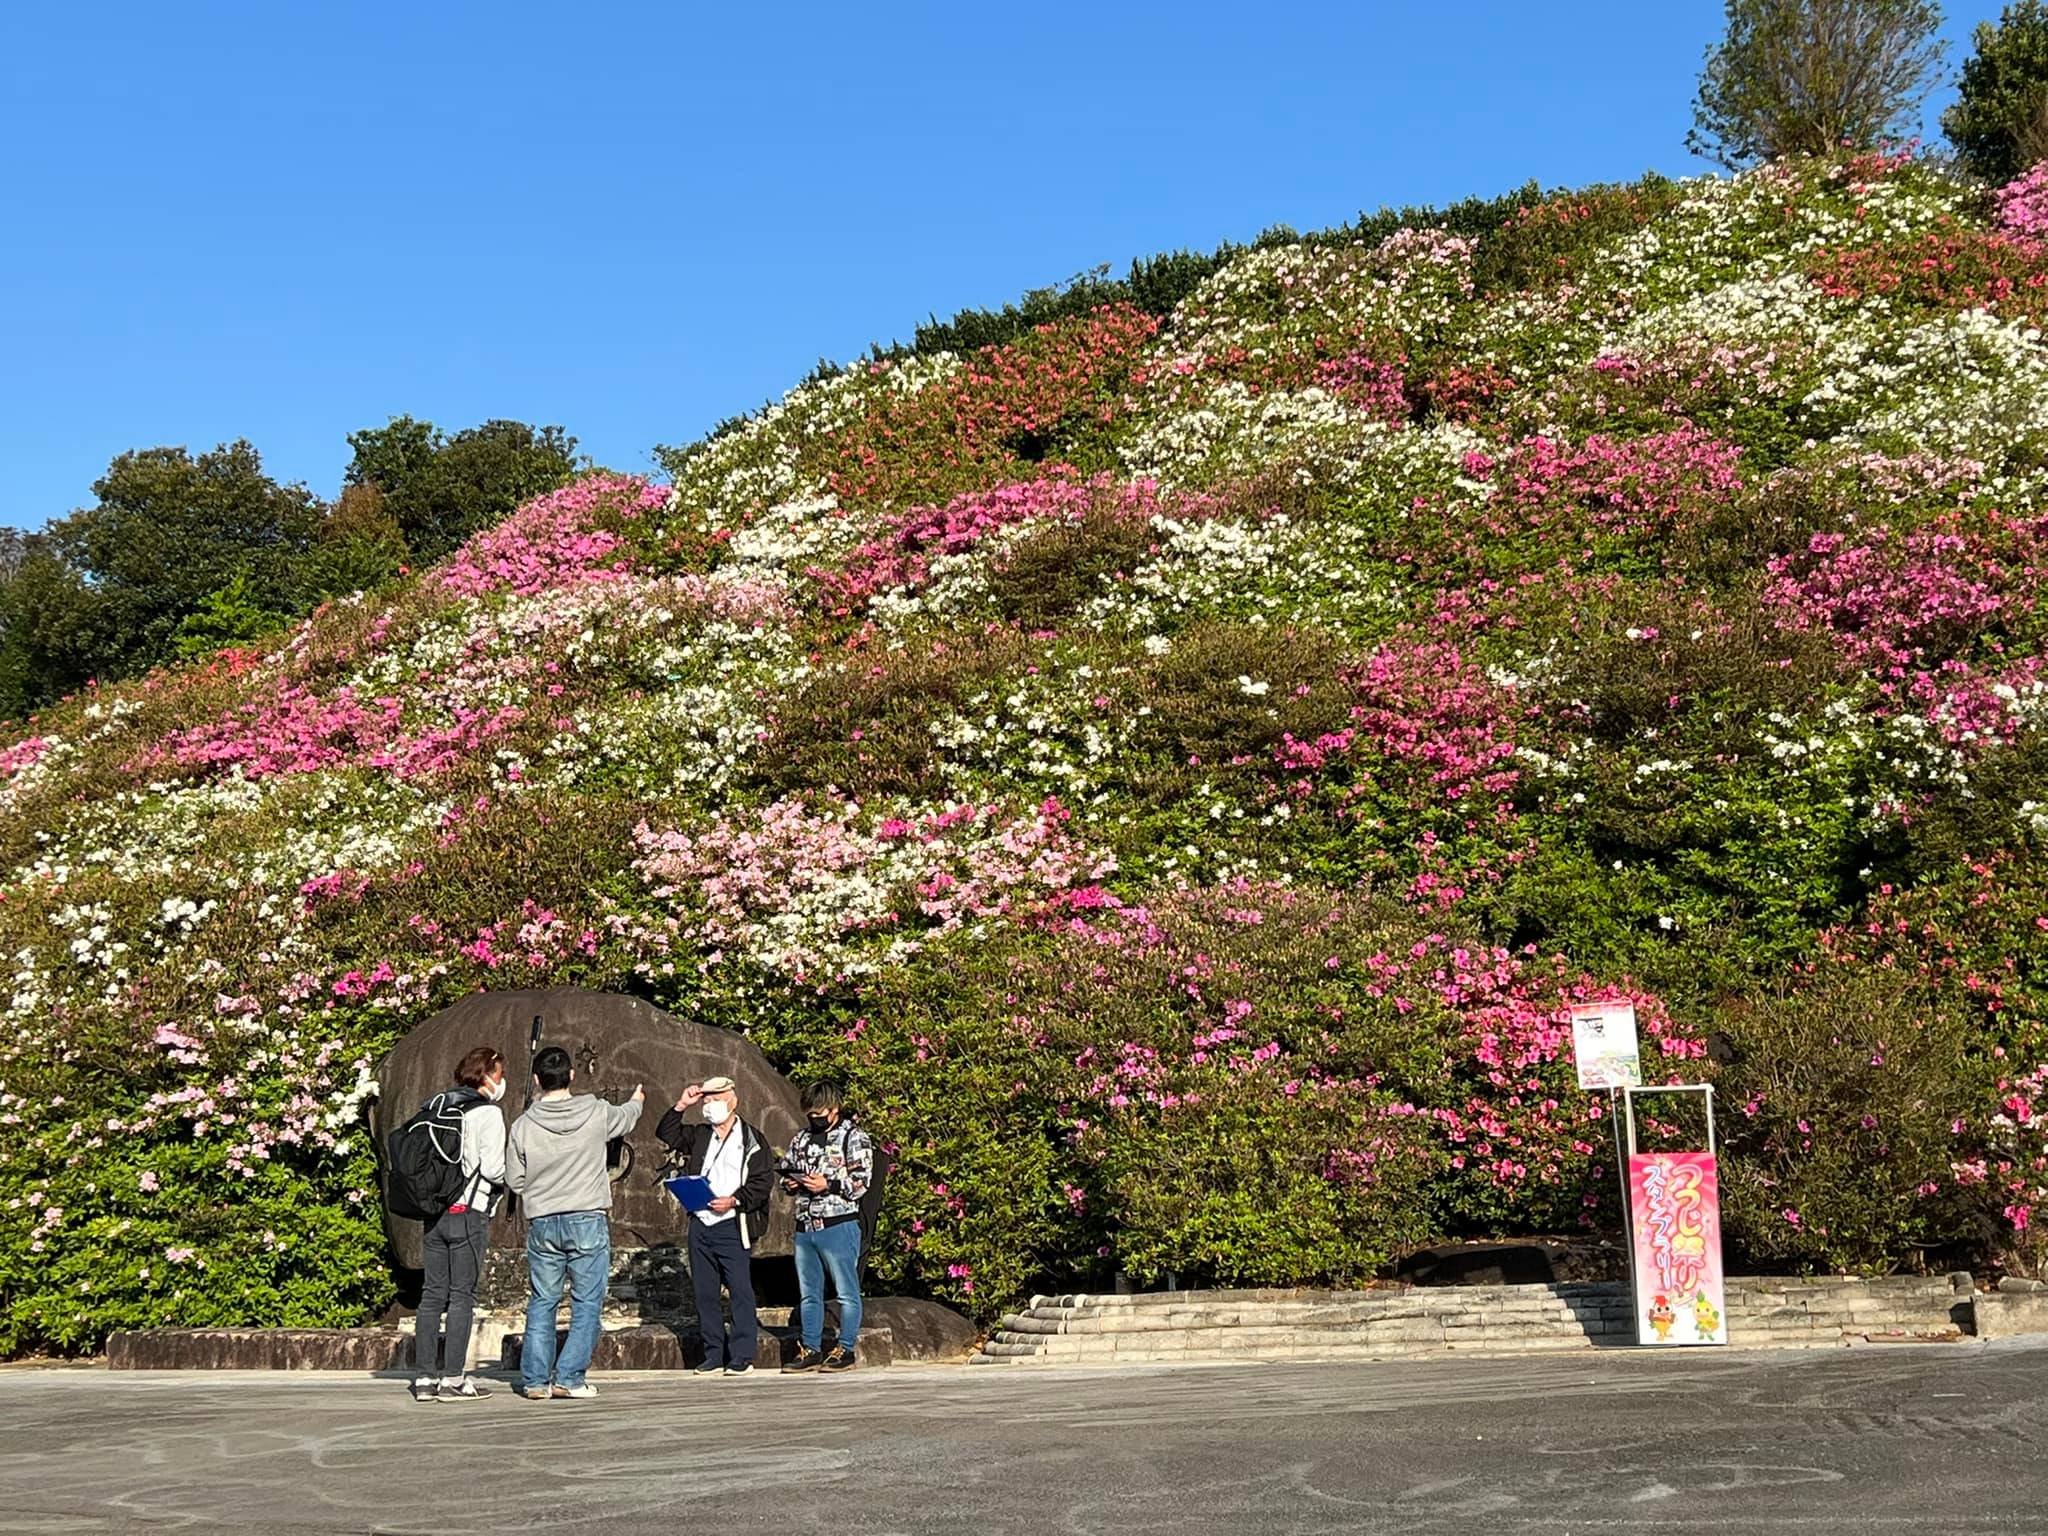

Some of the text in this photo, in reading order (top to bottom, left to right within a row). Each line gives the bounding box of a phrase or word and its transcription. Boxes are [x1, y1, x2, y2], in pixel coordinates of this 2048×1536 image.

[1642, 1164, 1672, 1290] スタンプラリー
[1671, 1162, 1705, 1290] つつじ祭り
